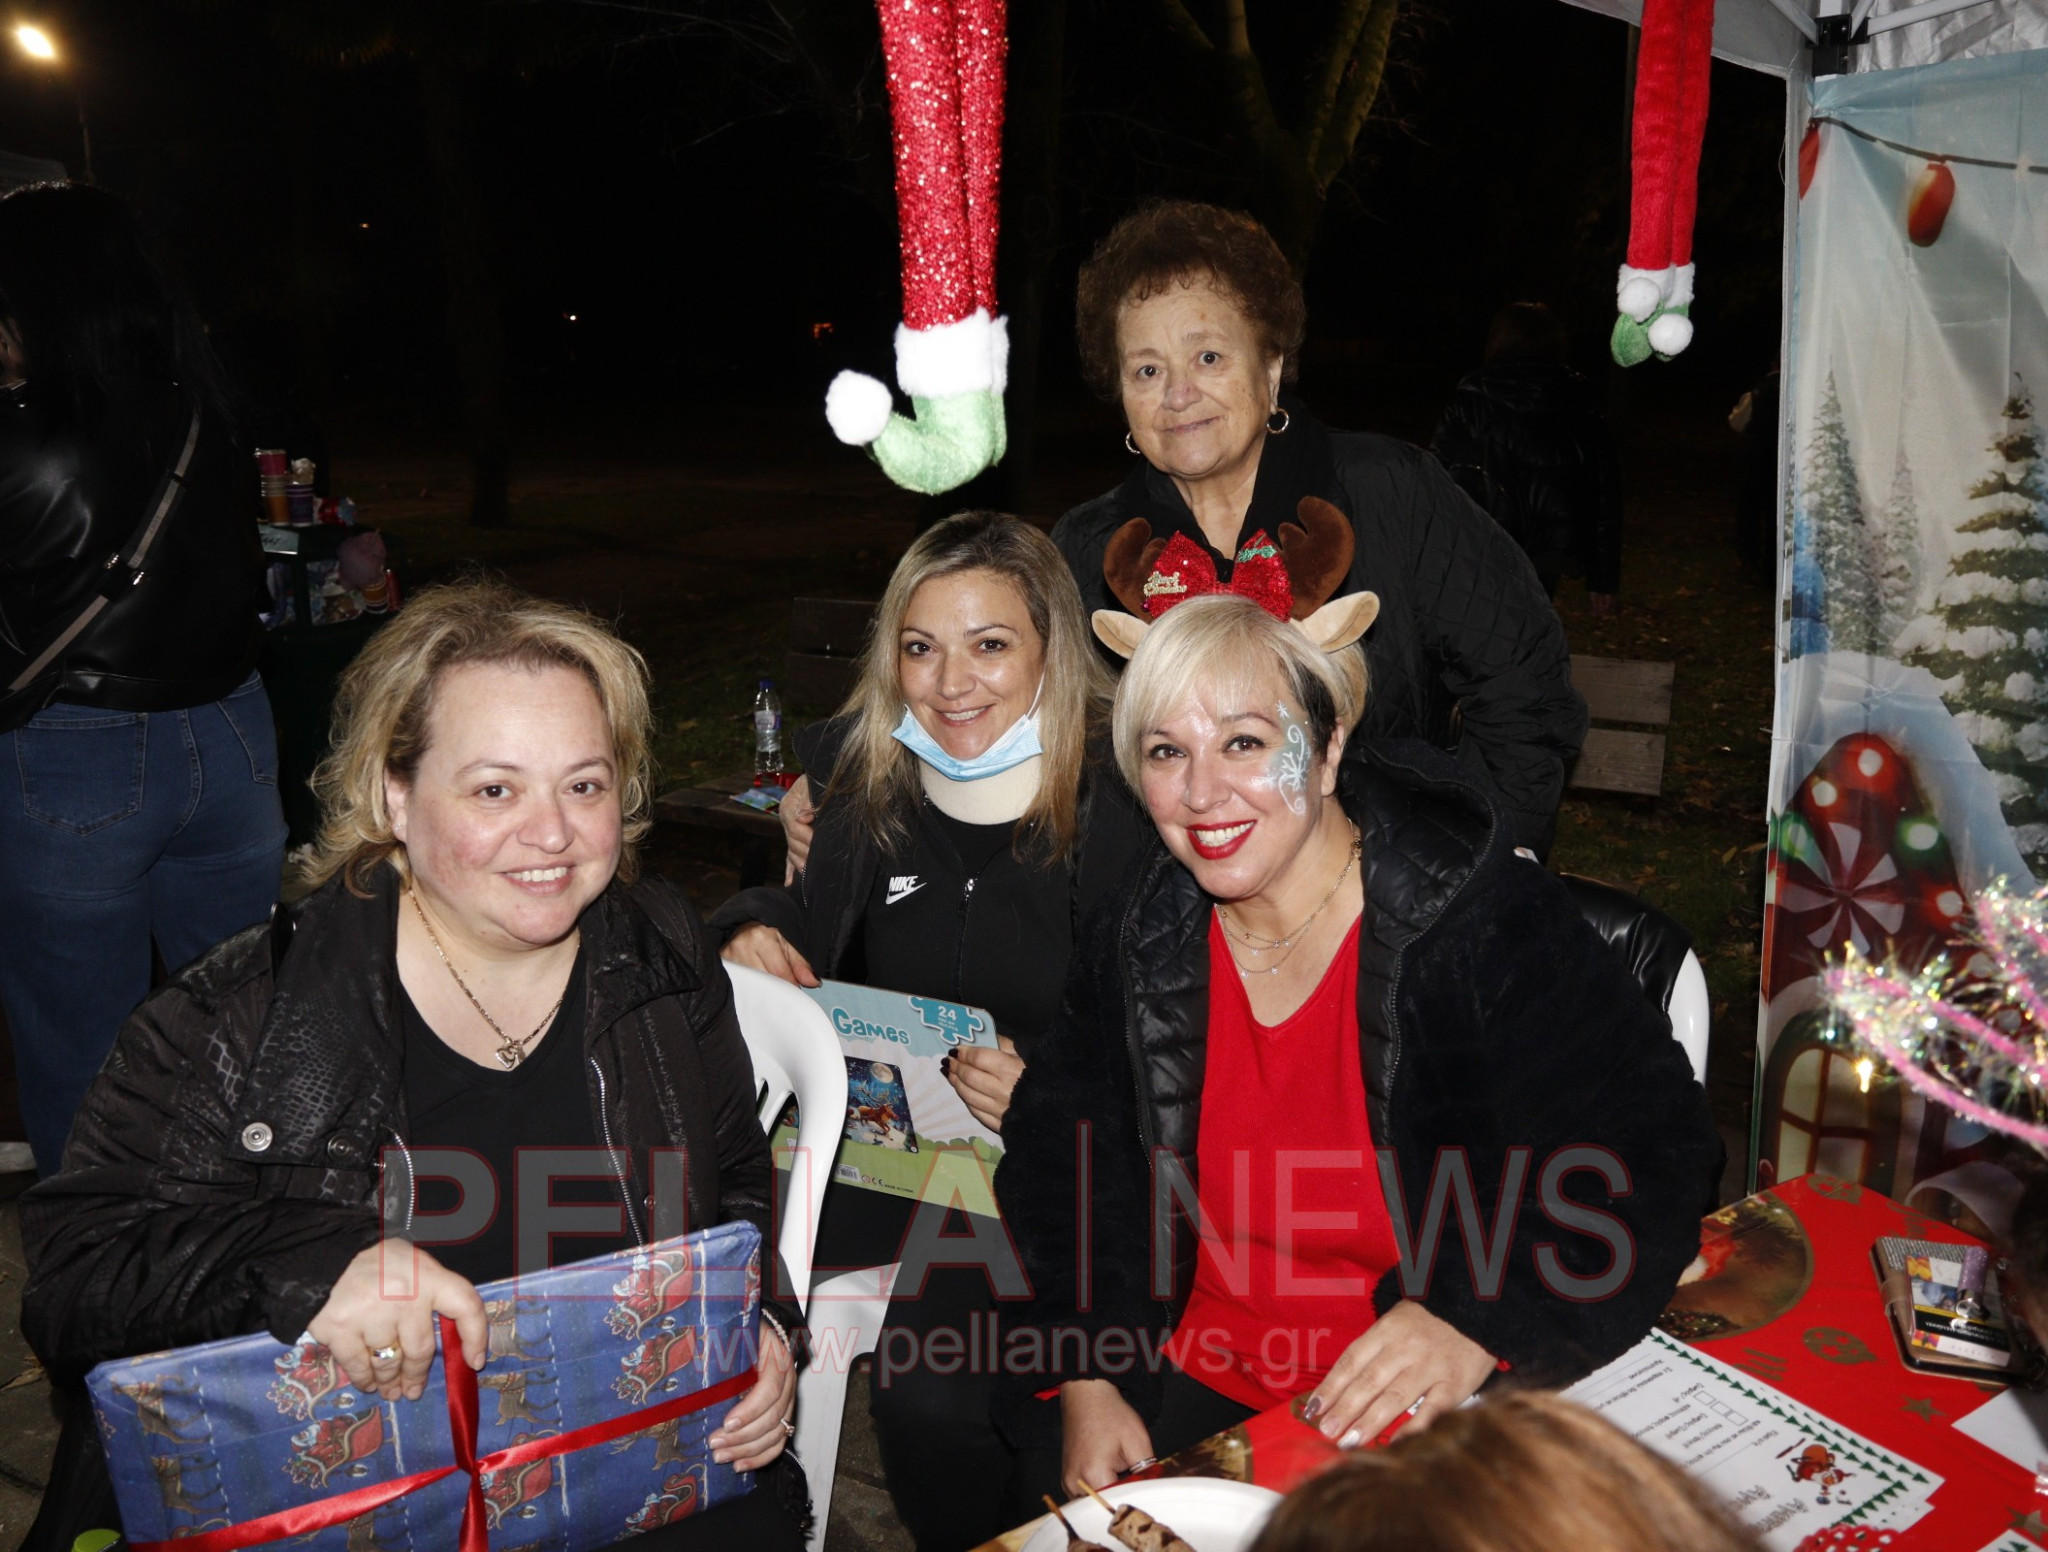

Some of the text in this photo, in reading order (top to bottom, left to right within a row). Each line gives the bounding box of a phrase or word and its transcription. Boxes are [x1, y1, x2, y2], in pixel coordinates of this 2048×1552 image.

[889, 875, 919, 892] NIKE
[937, 1005, 957, 1021] 24
[832, 1007, 911, 1045] Games
